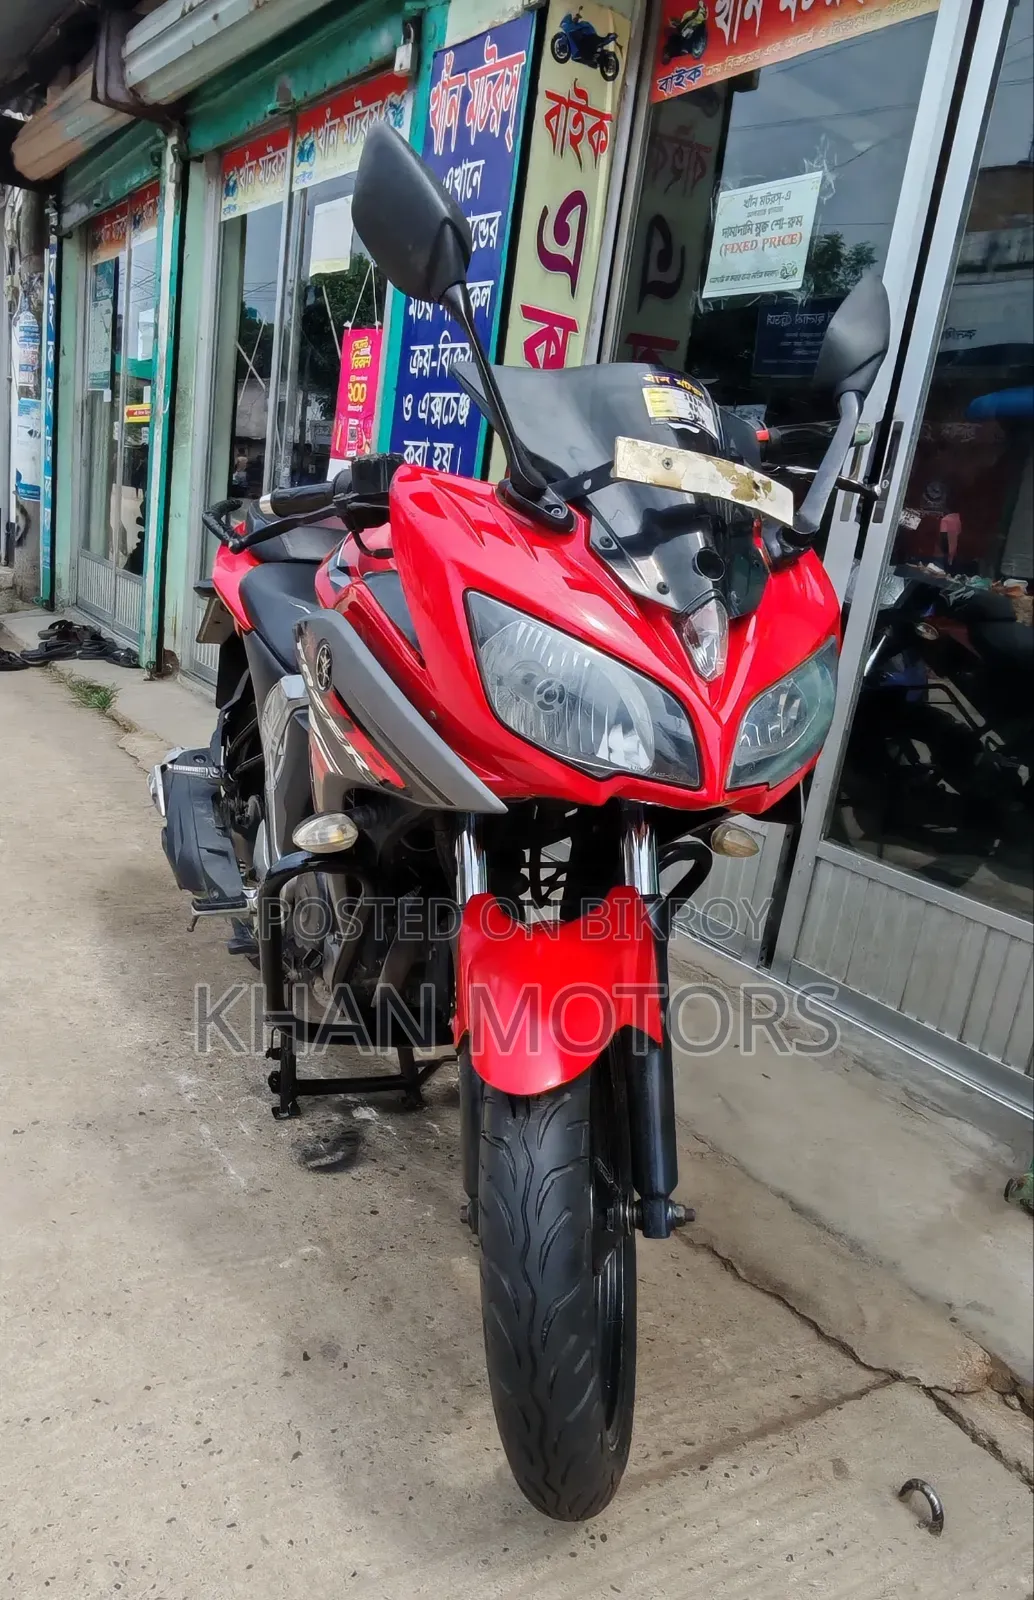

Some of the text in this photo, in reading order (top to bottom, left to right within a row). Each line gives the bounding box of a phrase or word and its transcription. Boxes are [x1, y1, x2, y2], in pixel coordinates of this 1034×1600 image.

[656, 64, 706, 96] বাইক
[544, 78, 614, 173] বাইক
[719, 231, 803, 258] (FIXED PRICE)
[402, 393, 414, 422] ও
